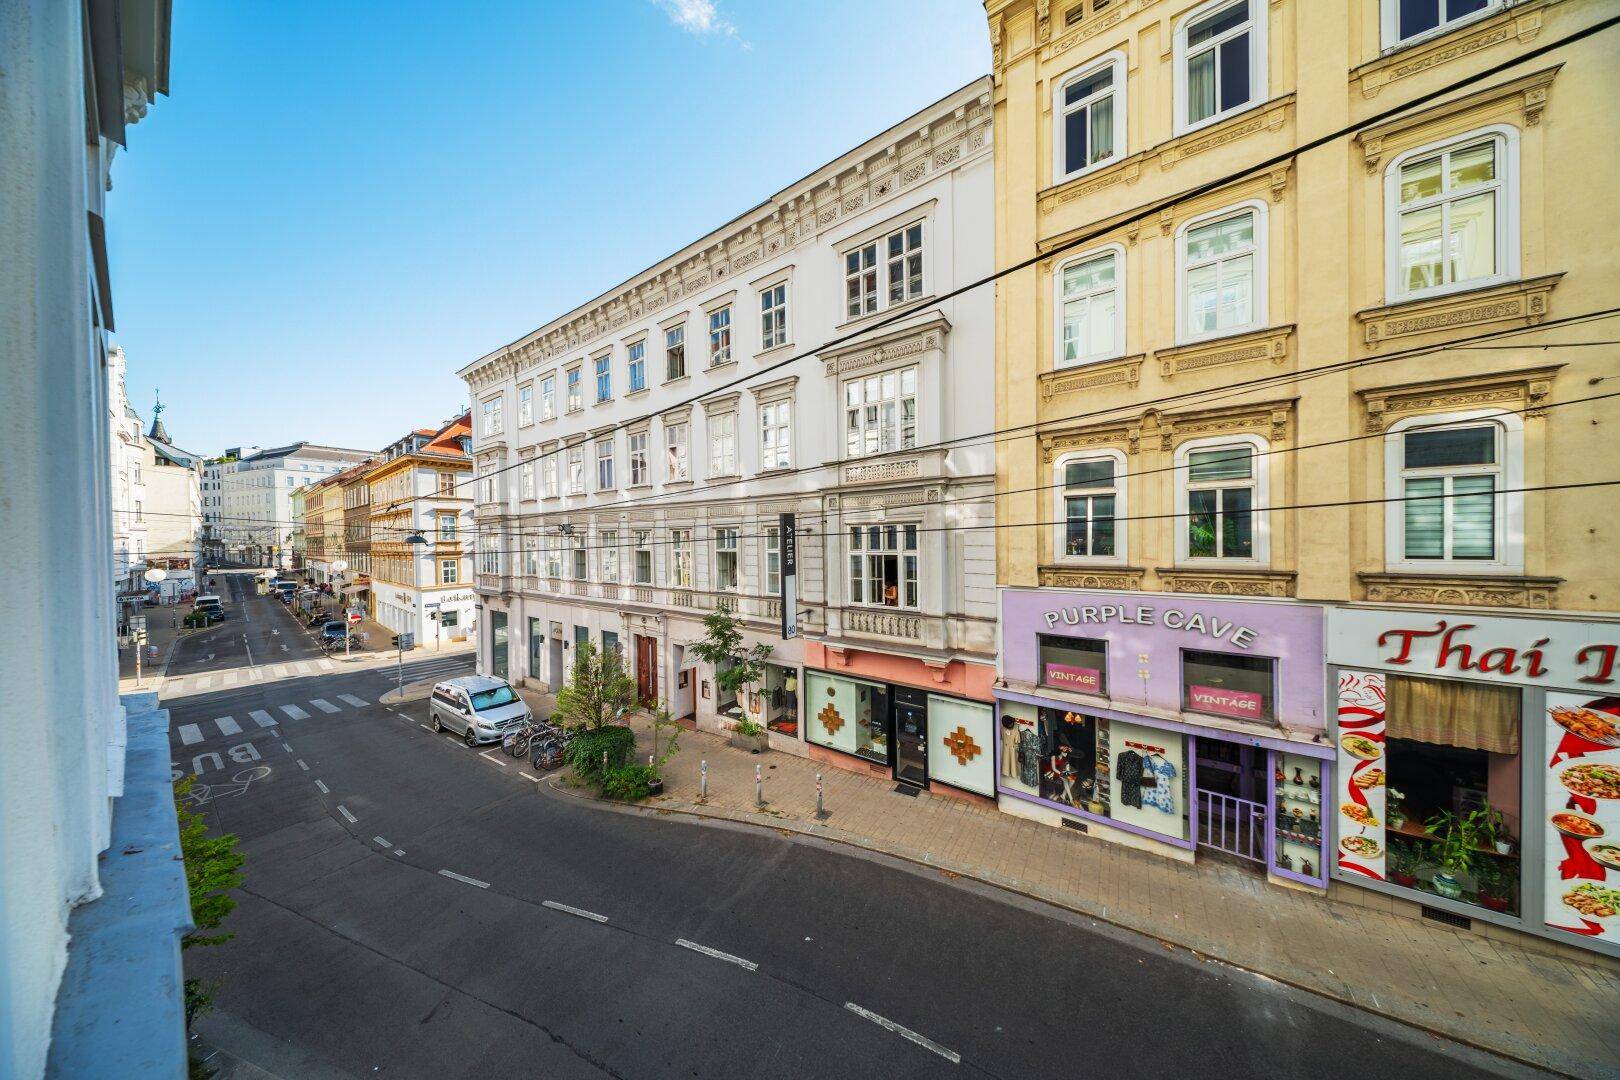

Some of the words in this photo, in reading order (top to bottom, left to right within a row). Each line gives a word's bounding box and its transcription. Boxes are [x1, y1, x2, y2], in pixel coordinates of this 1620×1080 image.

[786, 525, 794, 566] ATELIER
[787, 624, 796, 635] 80
[1042, 605, 1155, 629] PURPLE
[1163, 609, 1259, 649] CAVE
[1378, 620, 1550, 678] Thai
[1049, 670, 1097, 685] VINTAGE
[1193, 694, 1257, 711] VINTAGE
